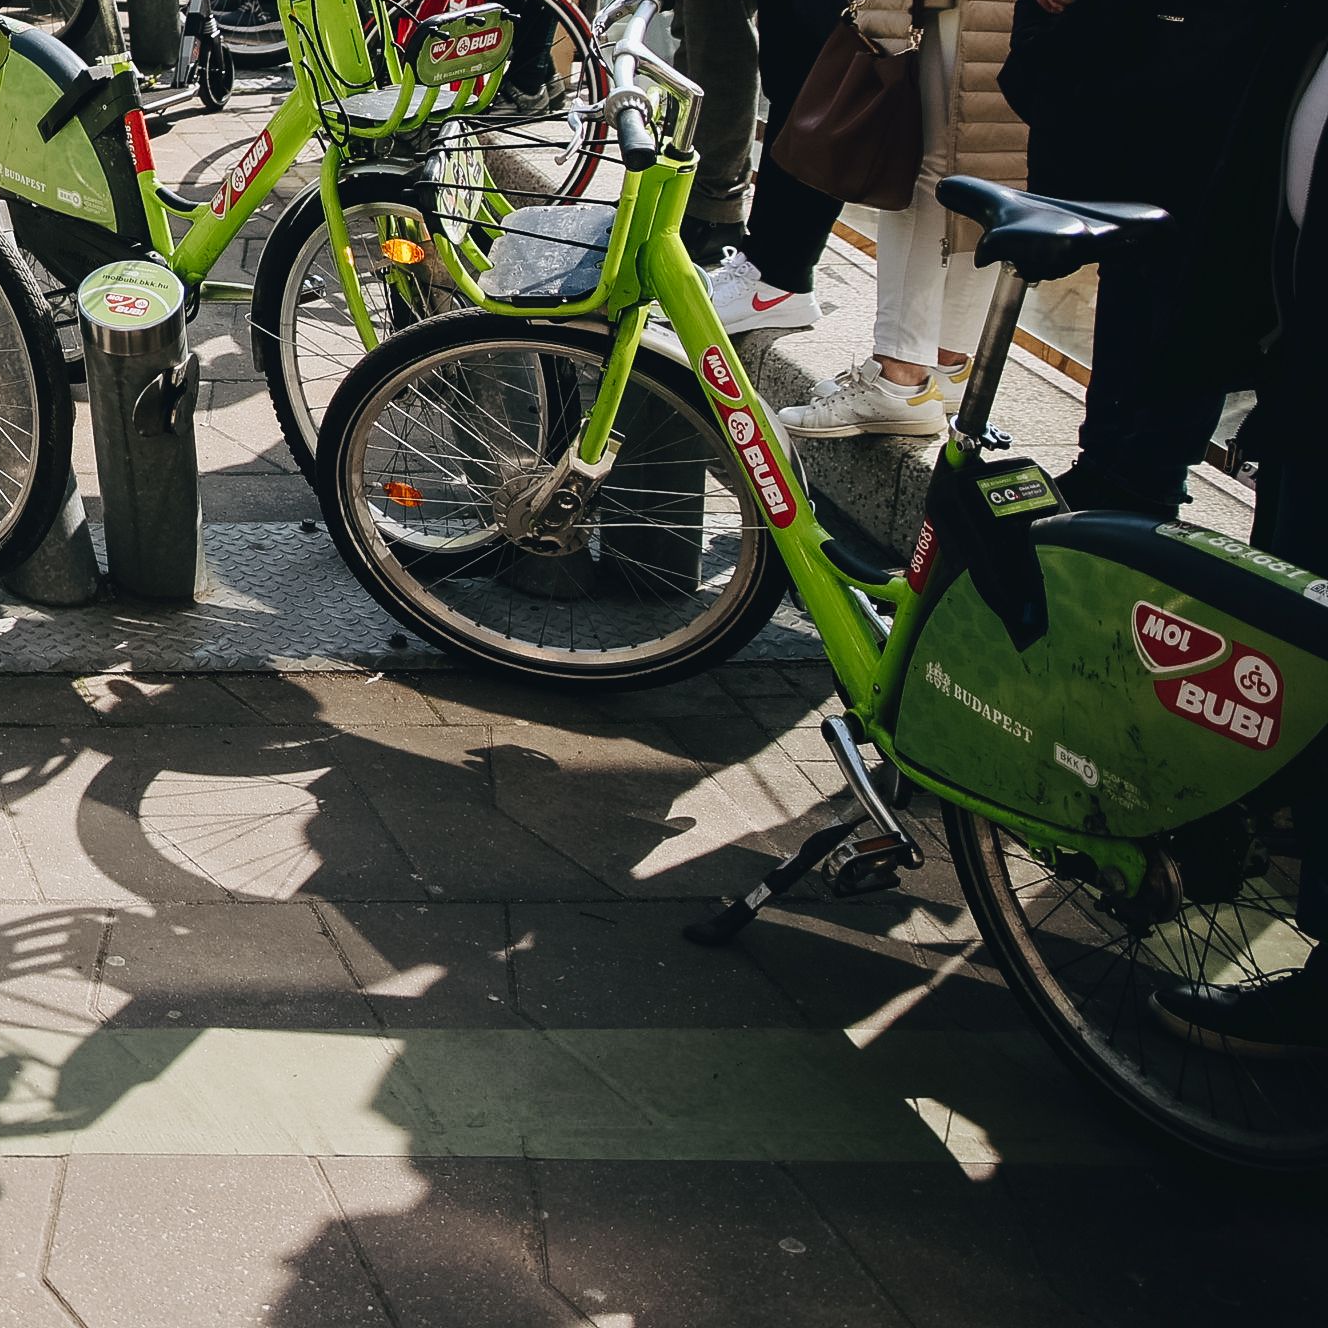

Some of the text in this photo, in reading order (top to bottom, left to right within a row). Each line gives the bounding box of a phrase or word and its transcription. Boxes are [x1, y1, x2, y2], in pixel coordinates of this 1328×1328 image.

[432, 32, 498, 54] MOL BUBI
[243, 137, 268, 174] BUBI
[3, 168, 48, 194] BUDAPEST
[102, 274, 169, 289] molbubi.bkk.hu
[115, 305, 146, 316] BUBI
[705, 354, 789, 515] MOL BUBI
[910, 520, 935, 574] 861681
[1142, 614, 1193, 653] MOL
[953, 682, 1033, 744] BUDAPEST
[1176, 680, 1274, 746] BUBI
[1060, 750, 1079, 769] BKK
